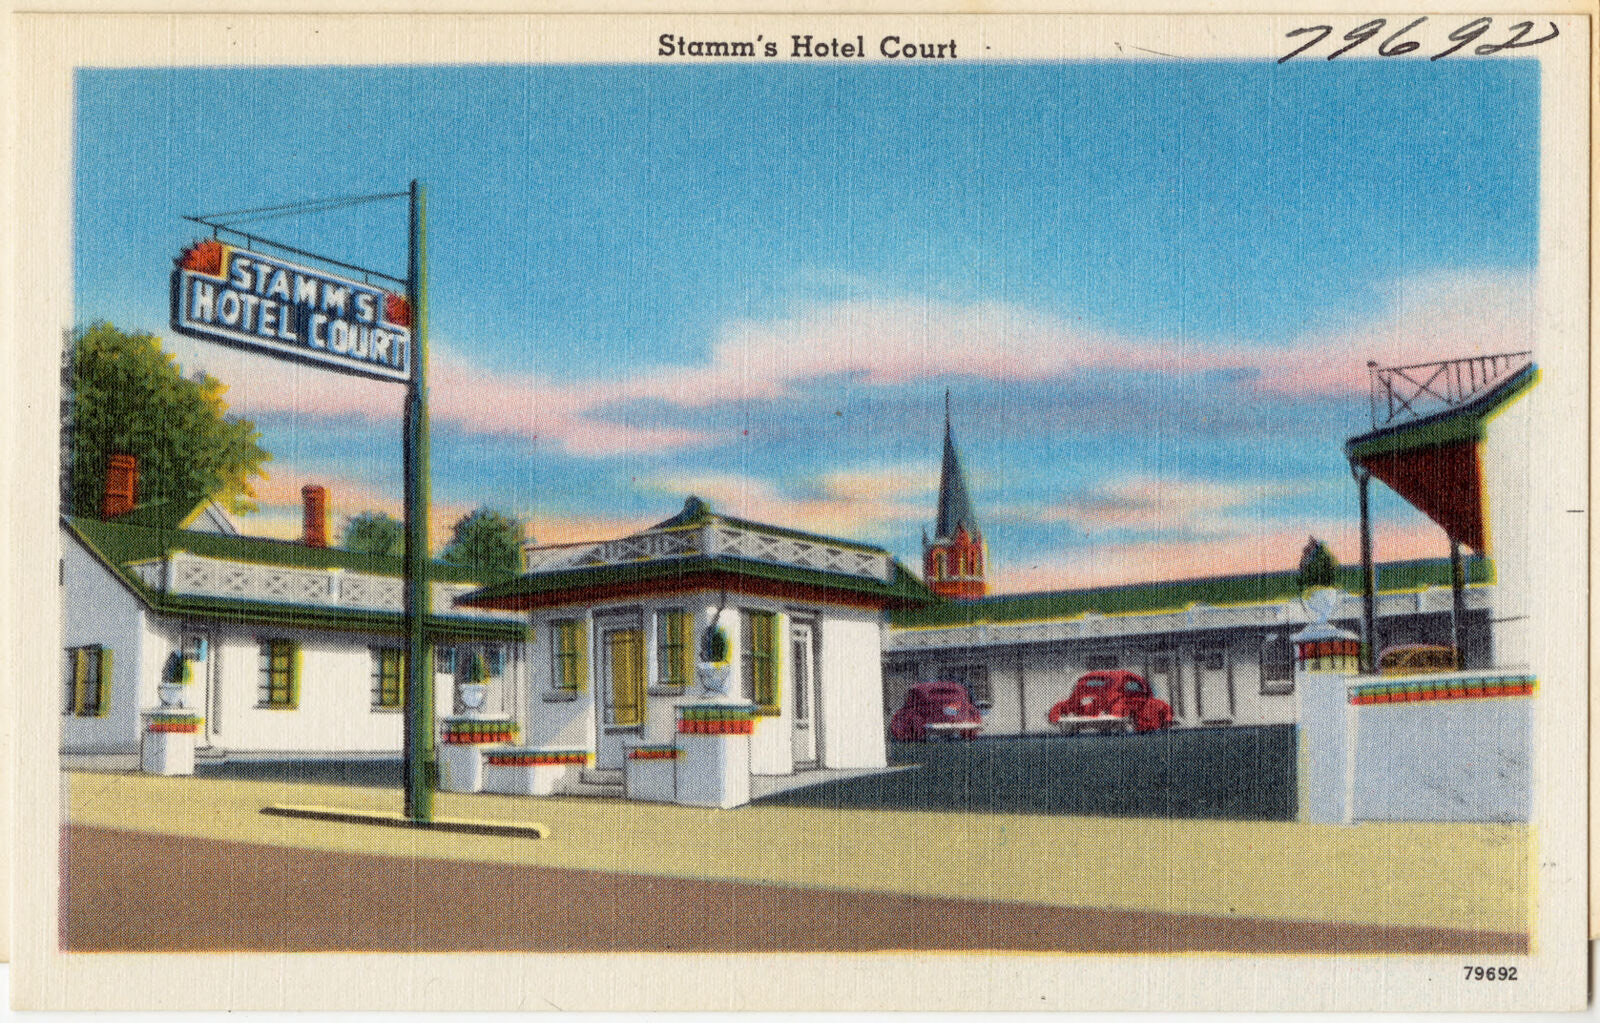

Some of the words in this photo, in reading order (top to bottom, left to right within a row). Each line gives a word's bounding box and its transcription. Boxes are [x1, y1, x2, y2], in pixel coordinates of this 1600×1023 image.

[1277, 16, 1560, 64] 79692
[190, 280, 298, 341] HOTEL
[308, 313, 405, 367] COURT
